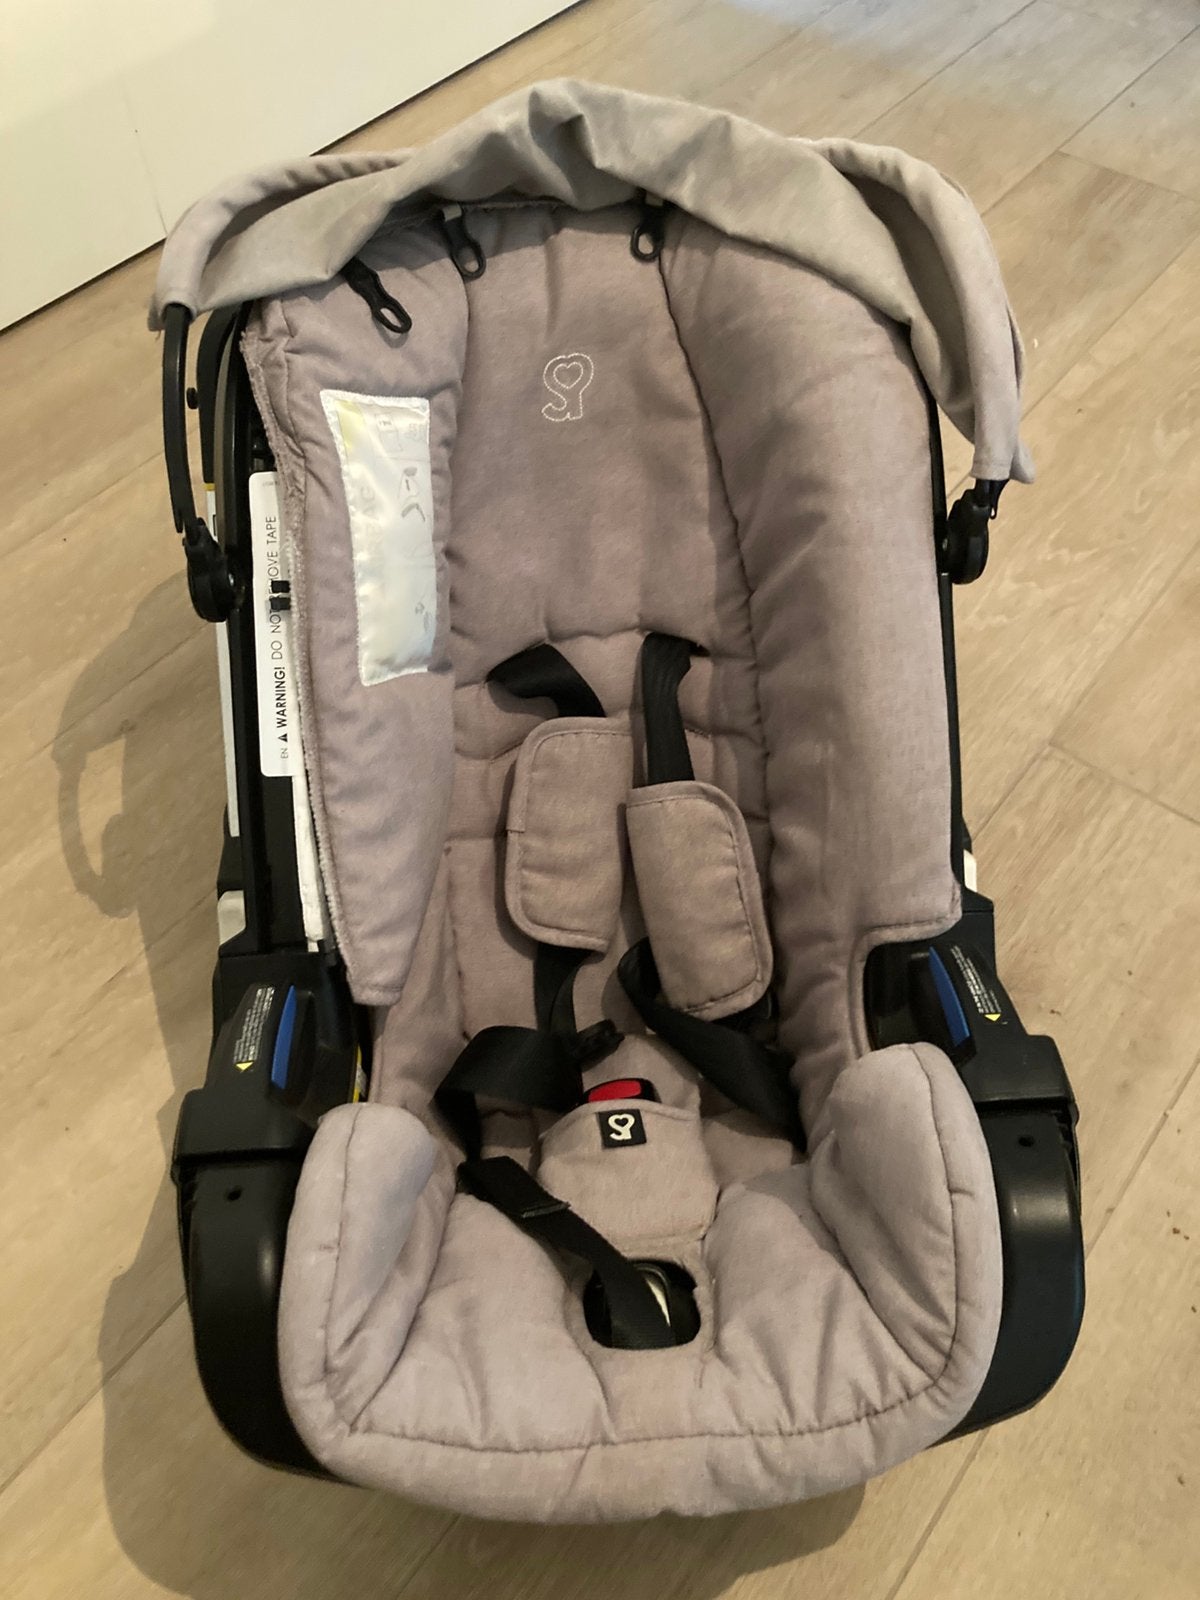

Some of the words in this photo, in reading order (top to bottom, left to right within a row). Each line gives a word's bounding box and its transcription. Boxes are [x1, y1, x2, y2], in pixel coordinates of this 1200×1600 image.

[265, 516, 276, 545] TAPE
[271, 640, 282, 660] DO
[274, 666, 287, 729] WARNING!
[281, 747, 288, 759] EN
